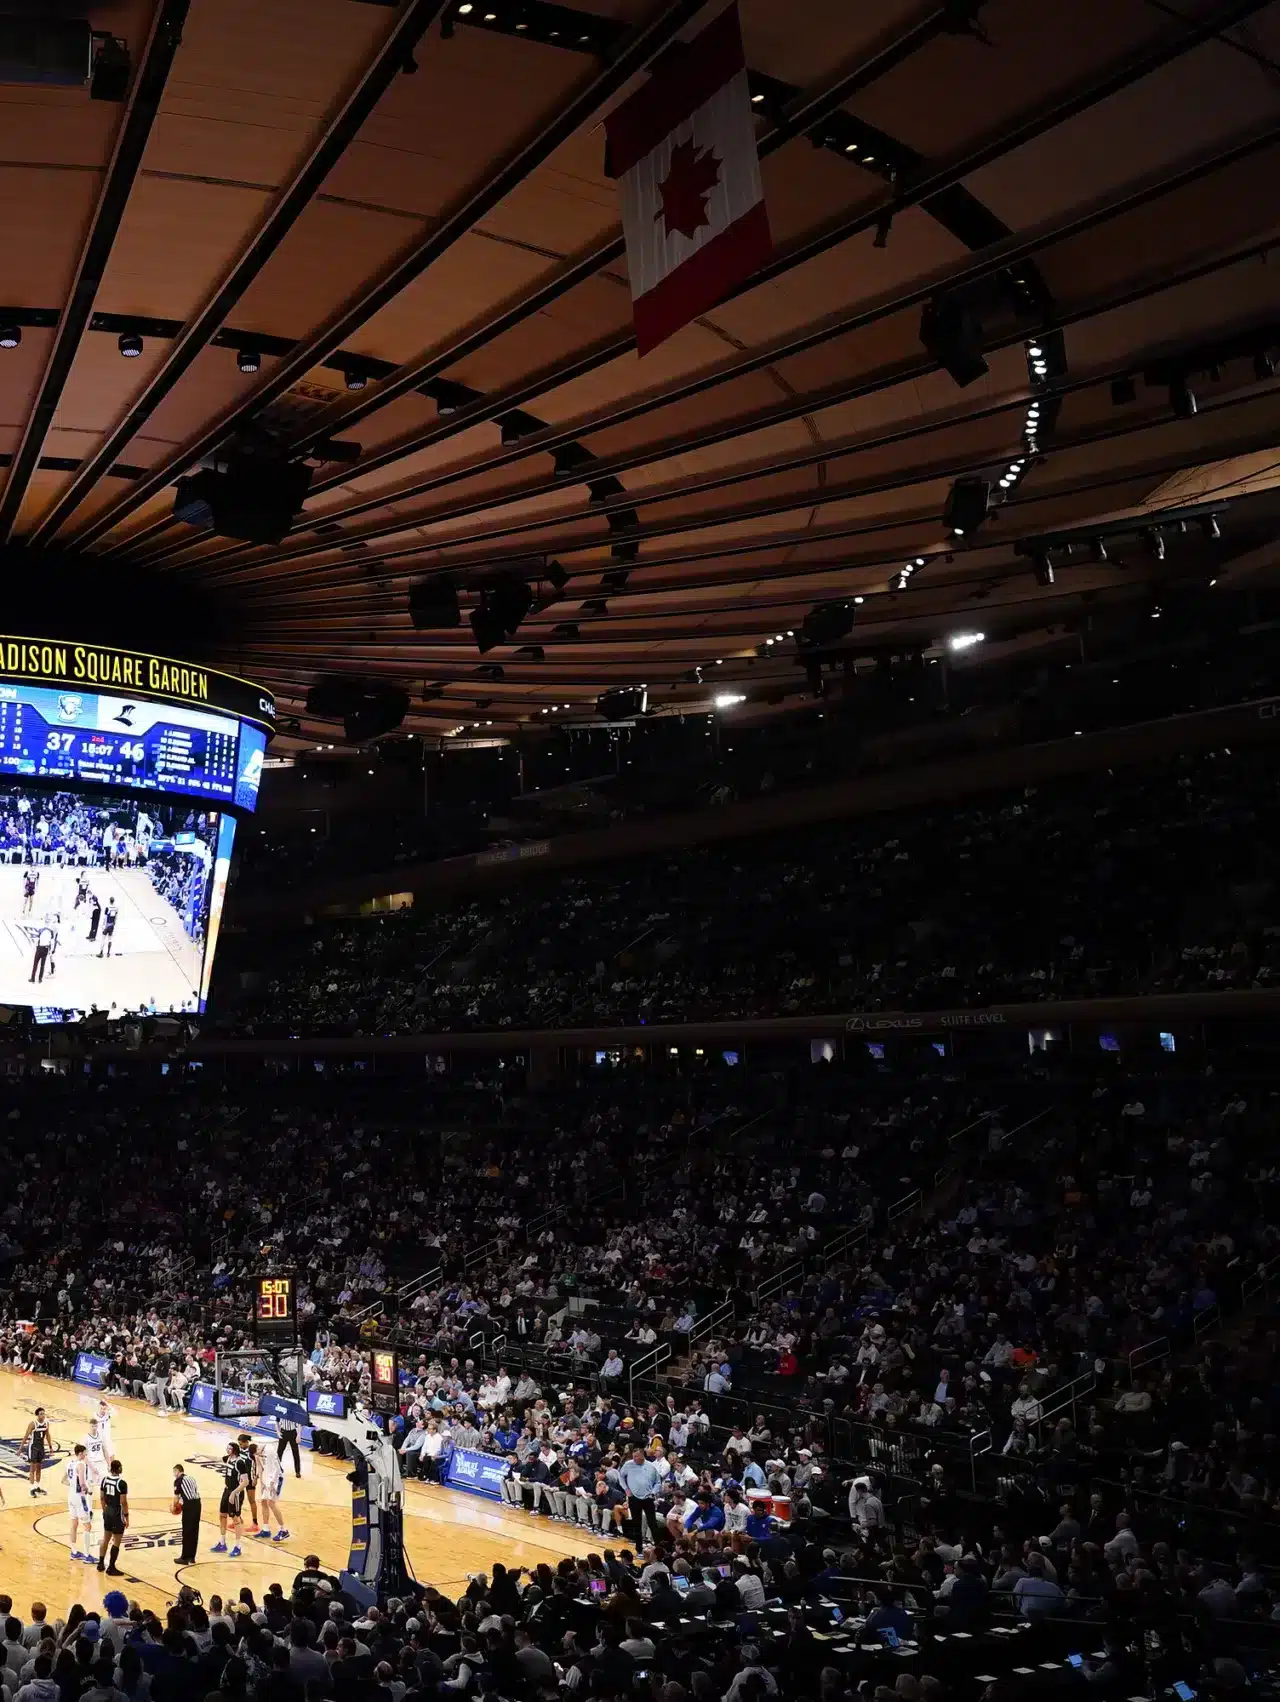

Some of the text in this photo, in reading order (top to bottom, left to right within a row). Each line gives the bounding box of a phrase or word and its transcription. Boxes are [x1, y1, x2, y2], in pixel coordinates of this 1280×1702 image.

[74, 646, 143, 686] SQUARE
[149, 658, 208, 700] GARDEN
[47, 732, 75, 752] 37
[82, 743, 114, 756] 15:07
[120, 741, 145, 762] 46
[866, 1013, 1007, 1029] LEXUS SUITE LEVEL
[262, 1280, 289, 1293] 15:07
[262, 1294, 288, 1318] 30
[379, 1367, 391, 1382] 30
